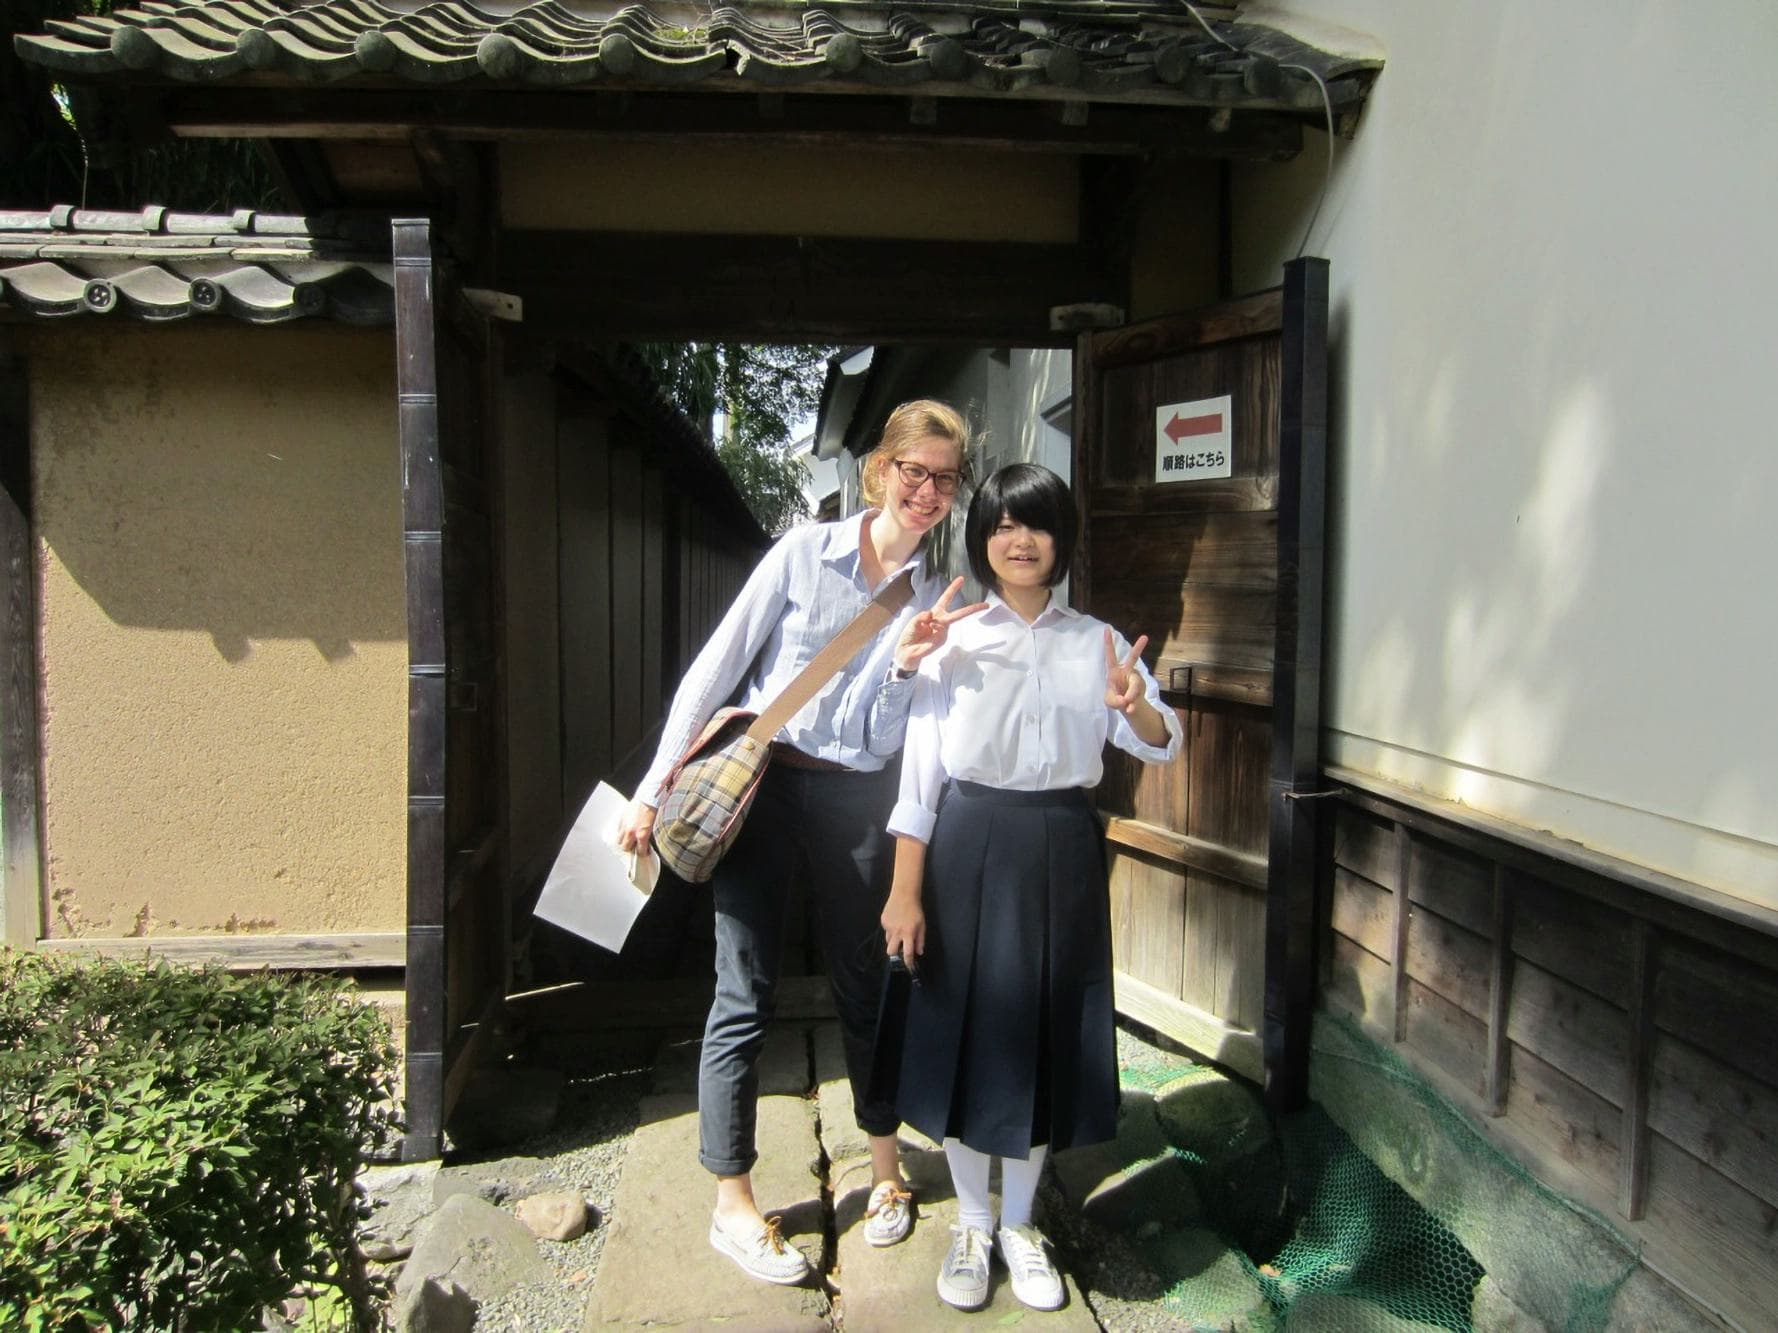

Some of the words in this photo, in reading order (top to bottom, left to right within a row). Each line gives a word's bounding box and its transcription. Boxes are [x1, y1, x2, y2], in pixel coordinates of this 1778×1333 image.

[1162, 451, 1225, 472] 順路はこちら
